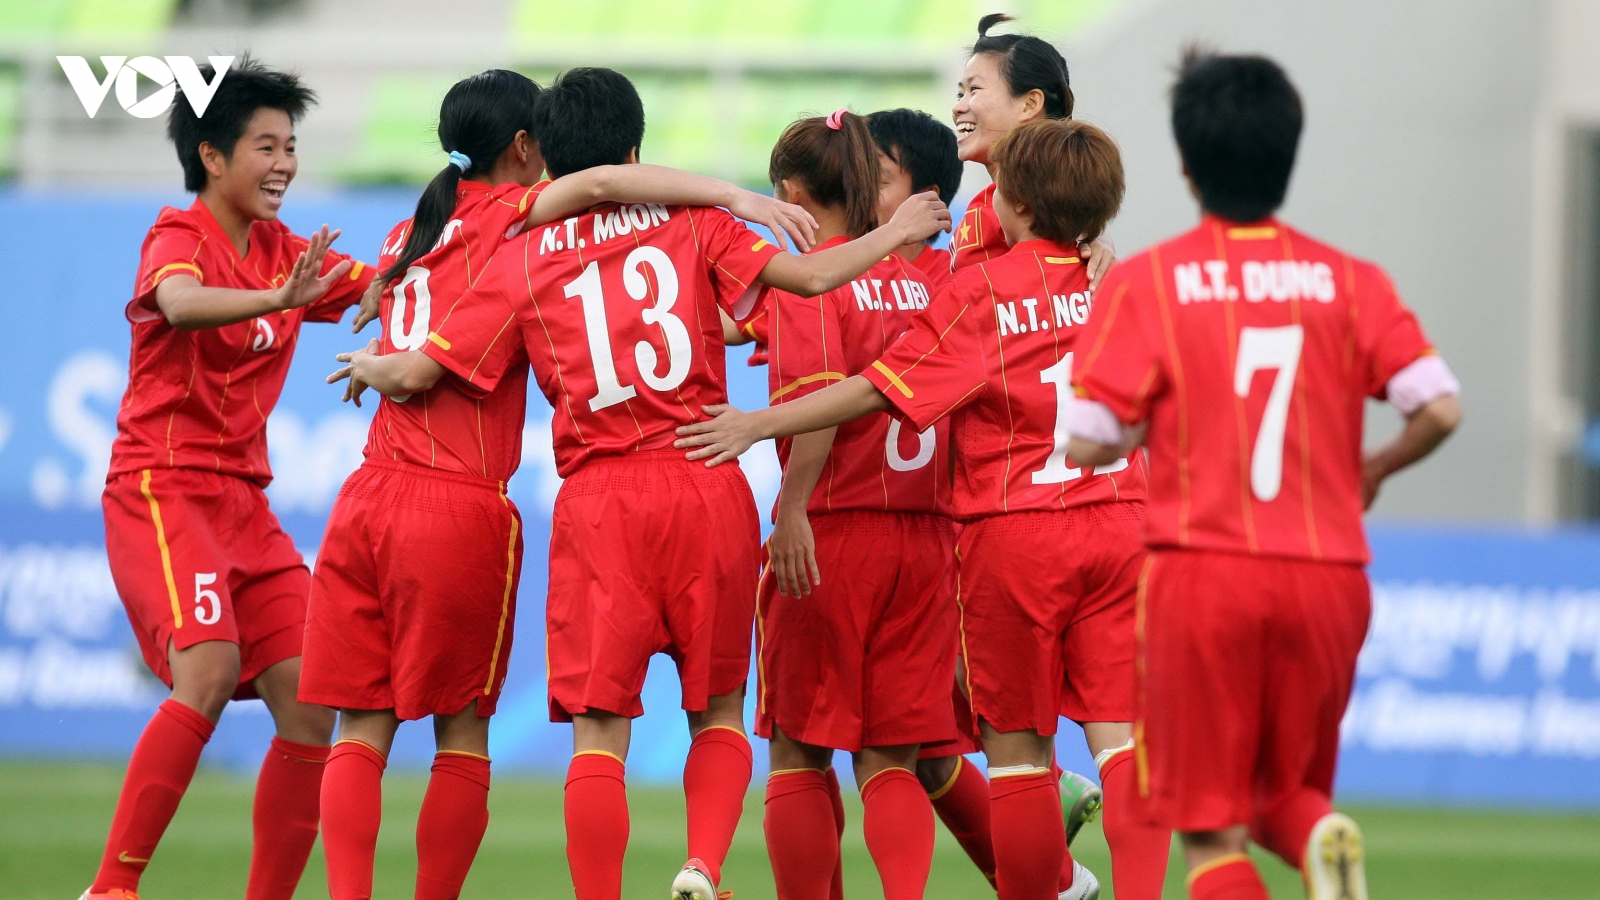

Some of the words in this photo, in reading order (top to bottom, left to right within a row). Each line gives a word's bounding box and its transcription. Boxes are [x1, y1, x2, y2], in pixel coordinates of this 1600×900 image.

[539, 217, 586, 255] N.T.
[594, 203, 670, 244] MUON
[851, 279, 892, 311] N.T.
[1173, 259, 1239, 305] N.T.
[1241, 260, 1337, 304] DUNG
[563, 246, 692, 412] 13
[997, 298, 1049, 336] N.T.
[1234, 325, 1304, 502] 7
[194, 572, 222, 625] 5
